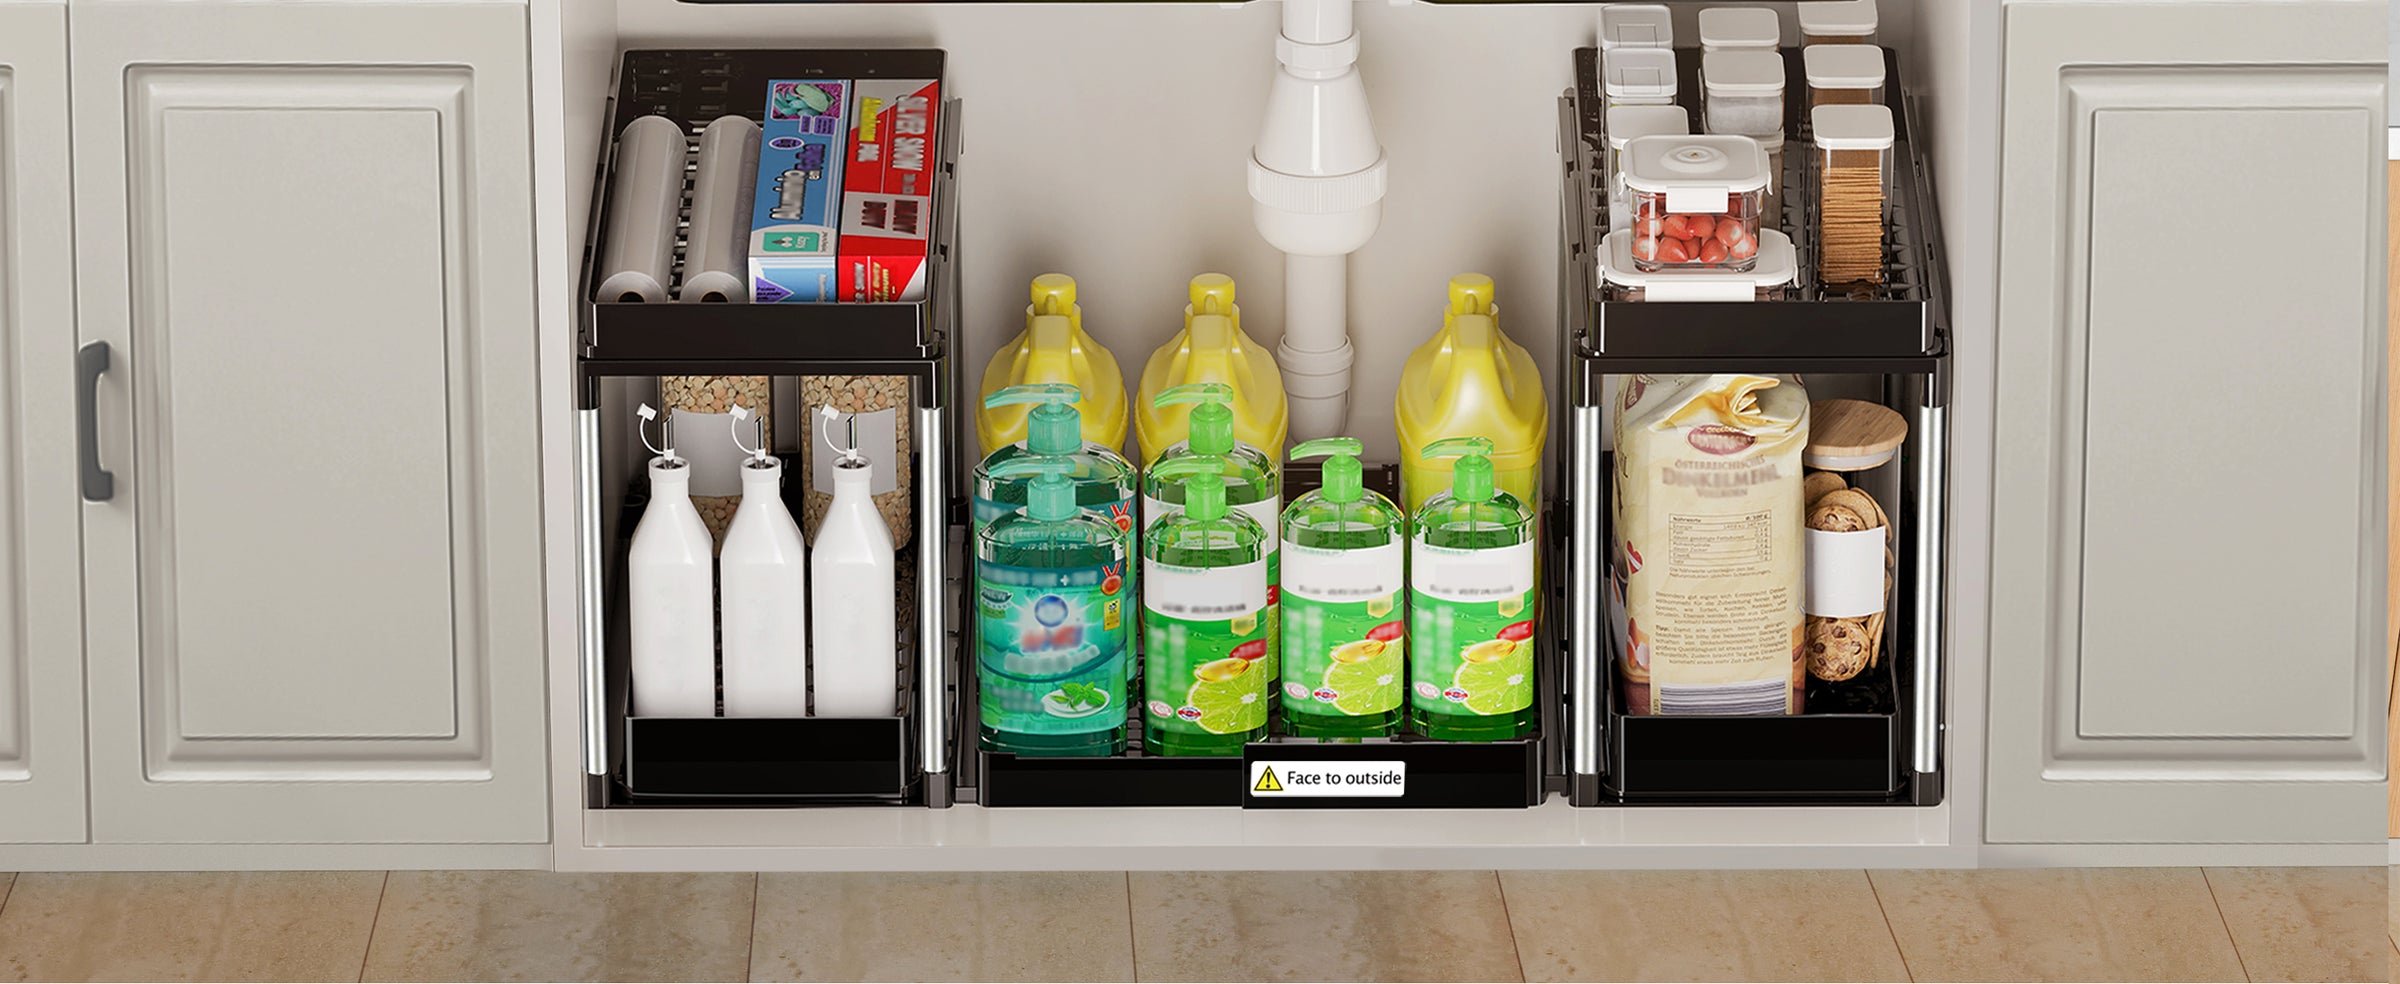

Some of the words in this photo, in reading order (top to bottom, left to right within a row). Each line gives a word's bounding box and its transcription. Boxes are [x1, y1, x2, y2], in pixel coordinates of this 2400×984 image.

[1288, 771, 1321, 785] Face
[1326, 773, 1341, 785] to
[1346, 770, 1402, 785] outside
